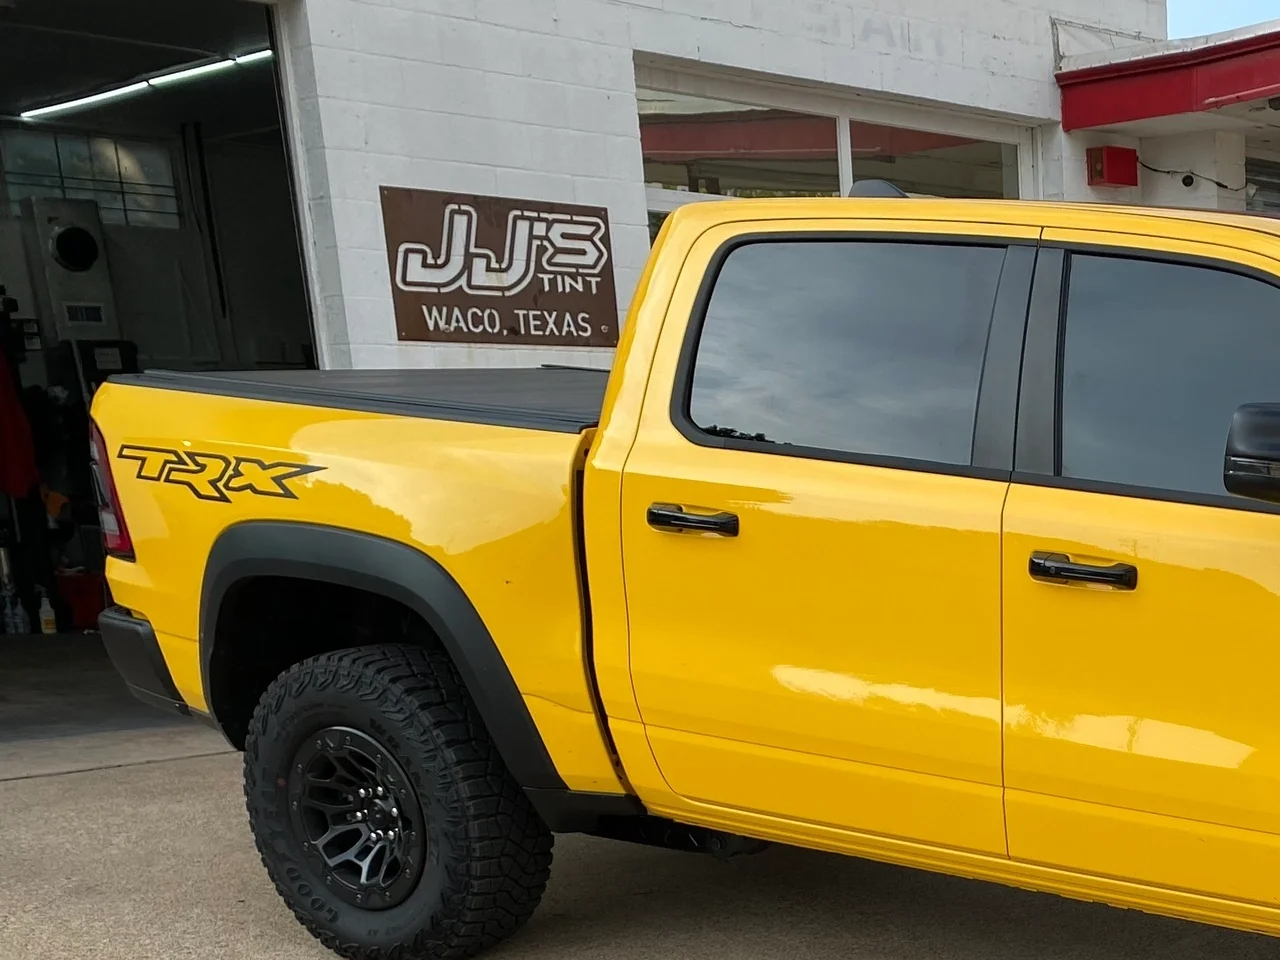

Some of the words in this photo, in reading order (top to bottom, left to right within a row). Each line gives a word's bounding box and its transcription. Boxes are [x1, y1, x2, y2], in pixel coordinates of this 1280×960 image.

[537, 273, 602, 295] TINT
[422, 304, 507, 337] WACO,
[514, 309, 592, 337] TEXAS
[117, 443, 328, 503] TRX
